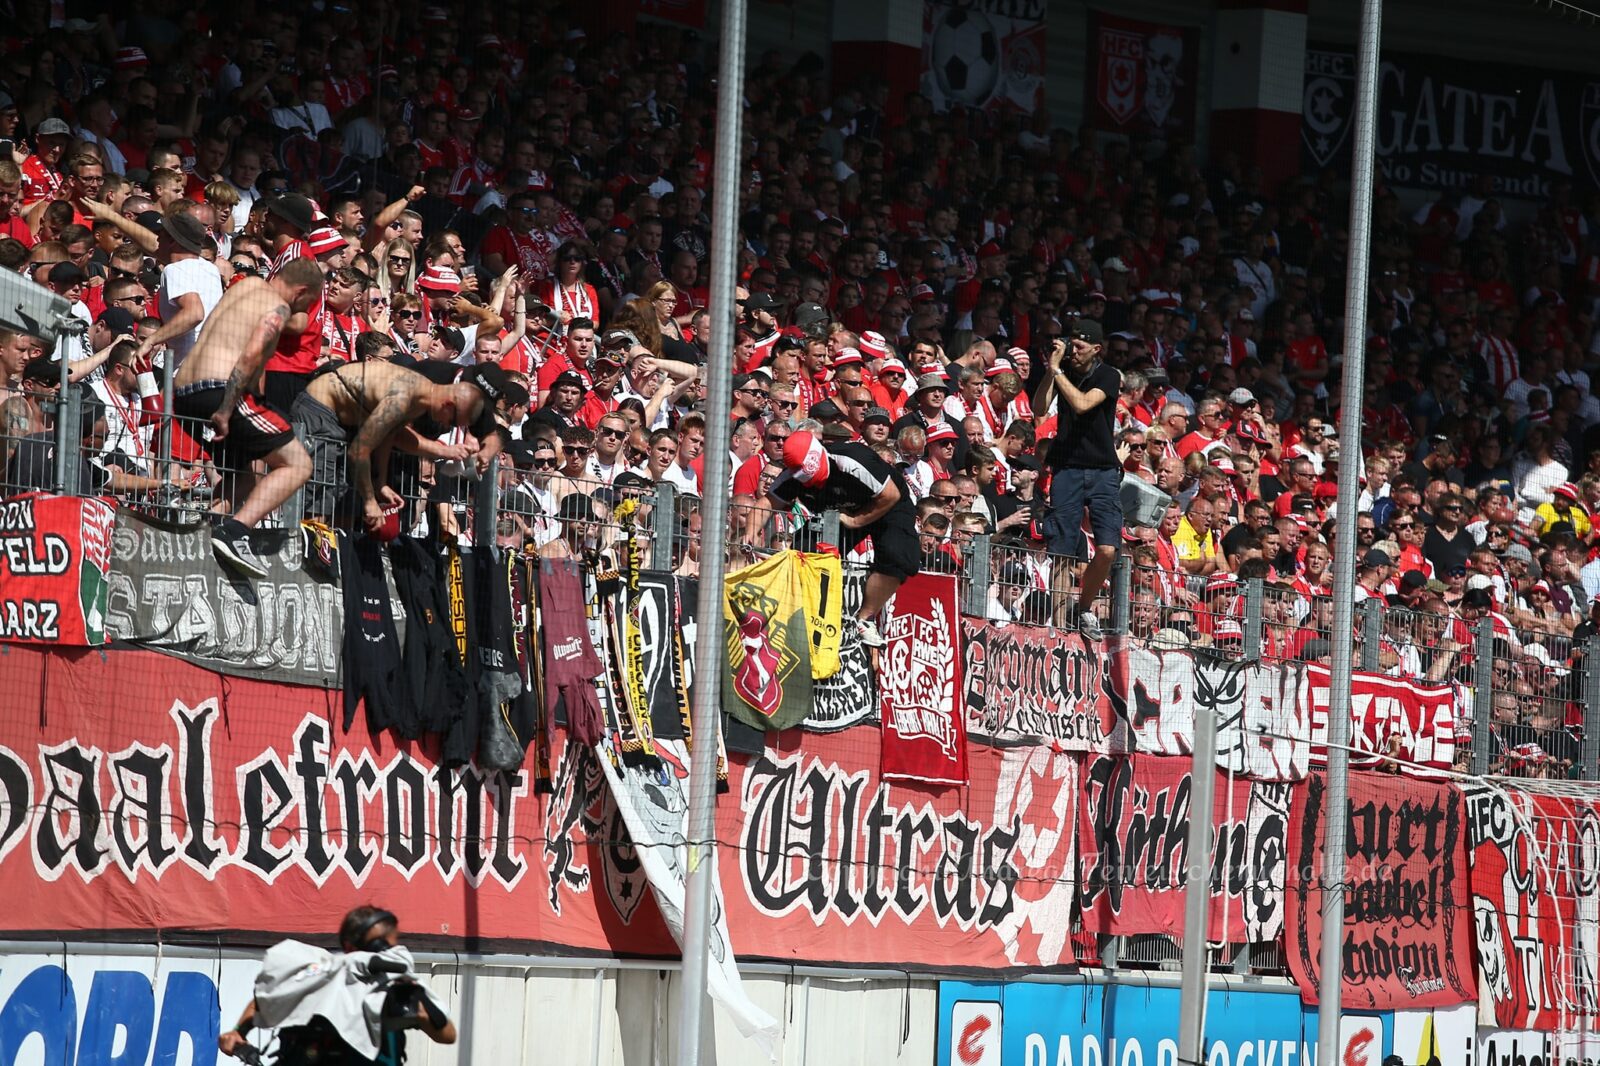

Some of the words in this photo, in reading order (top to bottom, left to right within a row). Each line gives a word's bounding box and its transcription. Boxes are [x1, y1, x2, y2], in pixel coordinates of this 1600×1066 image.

[1104, 34, 1141, 56] HFC
[1306, 54, 1345, 75] HFC
[0, 536, 70, 574] ELD
[0, 600, 59, 638] ARZ
[890, 617, 908, 638] HFC
[919, 624, 934, 643] FC
[914, 638, 938, 664] RWE
[1080, 756, 1248, 916] Köthn
[1318, 795, 1447, 865] urt
[1466, 793, 1507, 847] HFC
[739, 747, 1024, 932] Ultras
[1316, 862, 1440, 930] abbel
[1316, 925, 1443, 986] tadion
[1158, 1037, 1319, 1066] BOCKEN
